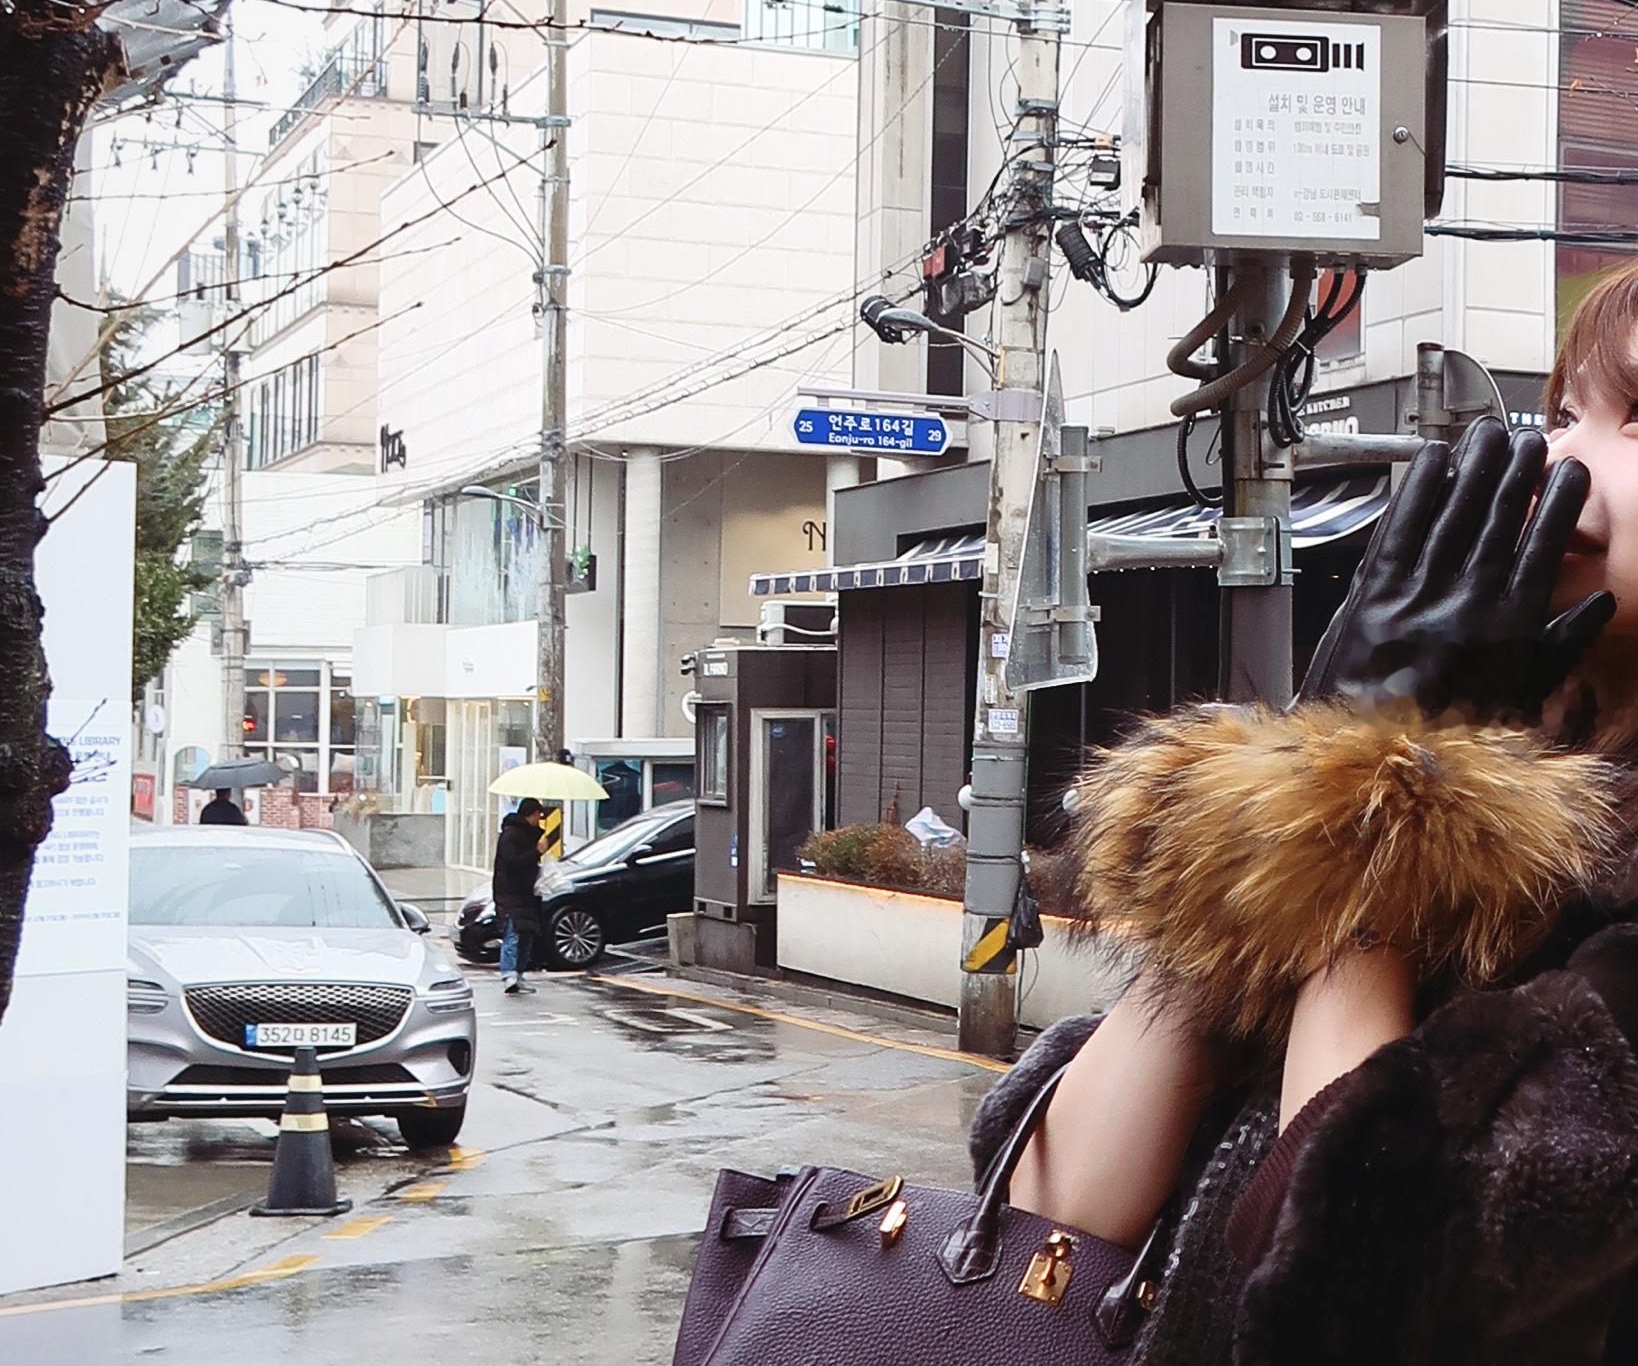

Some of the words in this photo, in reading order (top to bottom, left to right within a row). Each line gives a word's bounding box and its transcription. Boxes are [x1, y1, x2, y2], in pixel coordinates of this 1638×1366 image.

[1268, 93, 1292, 113] 설치
[1296, 94, 1309, 115] 및
[1313, 95, 1337, 115] 운영
[1341, 96, 1366, 116] 안내
[798, 420, 814, 433] 25
[828, 414, 914, 436] 언주로164길
[1509, 412, 1544, 426] THE
[828, 432, 875, 446] Eonju-ro
[878, 435, 913, 449] 164-gil
[309, 1026, 352, 1043] 8145
